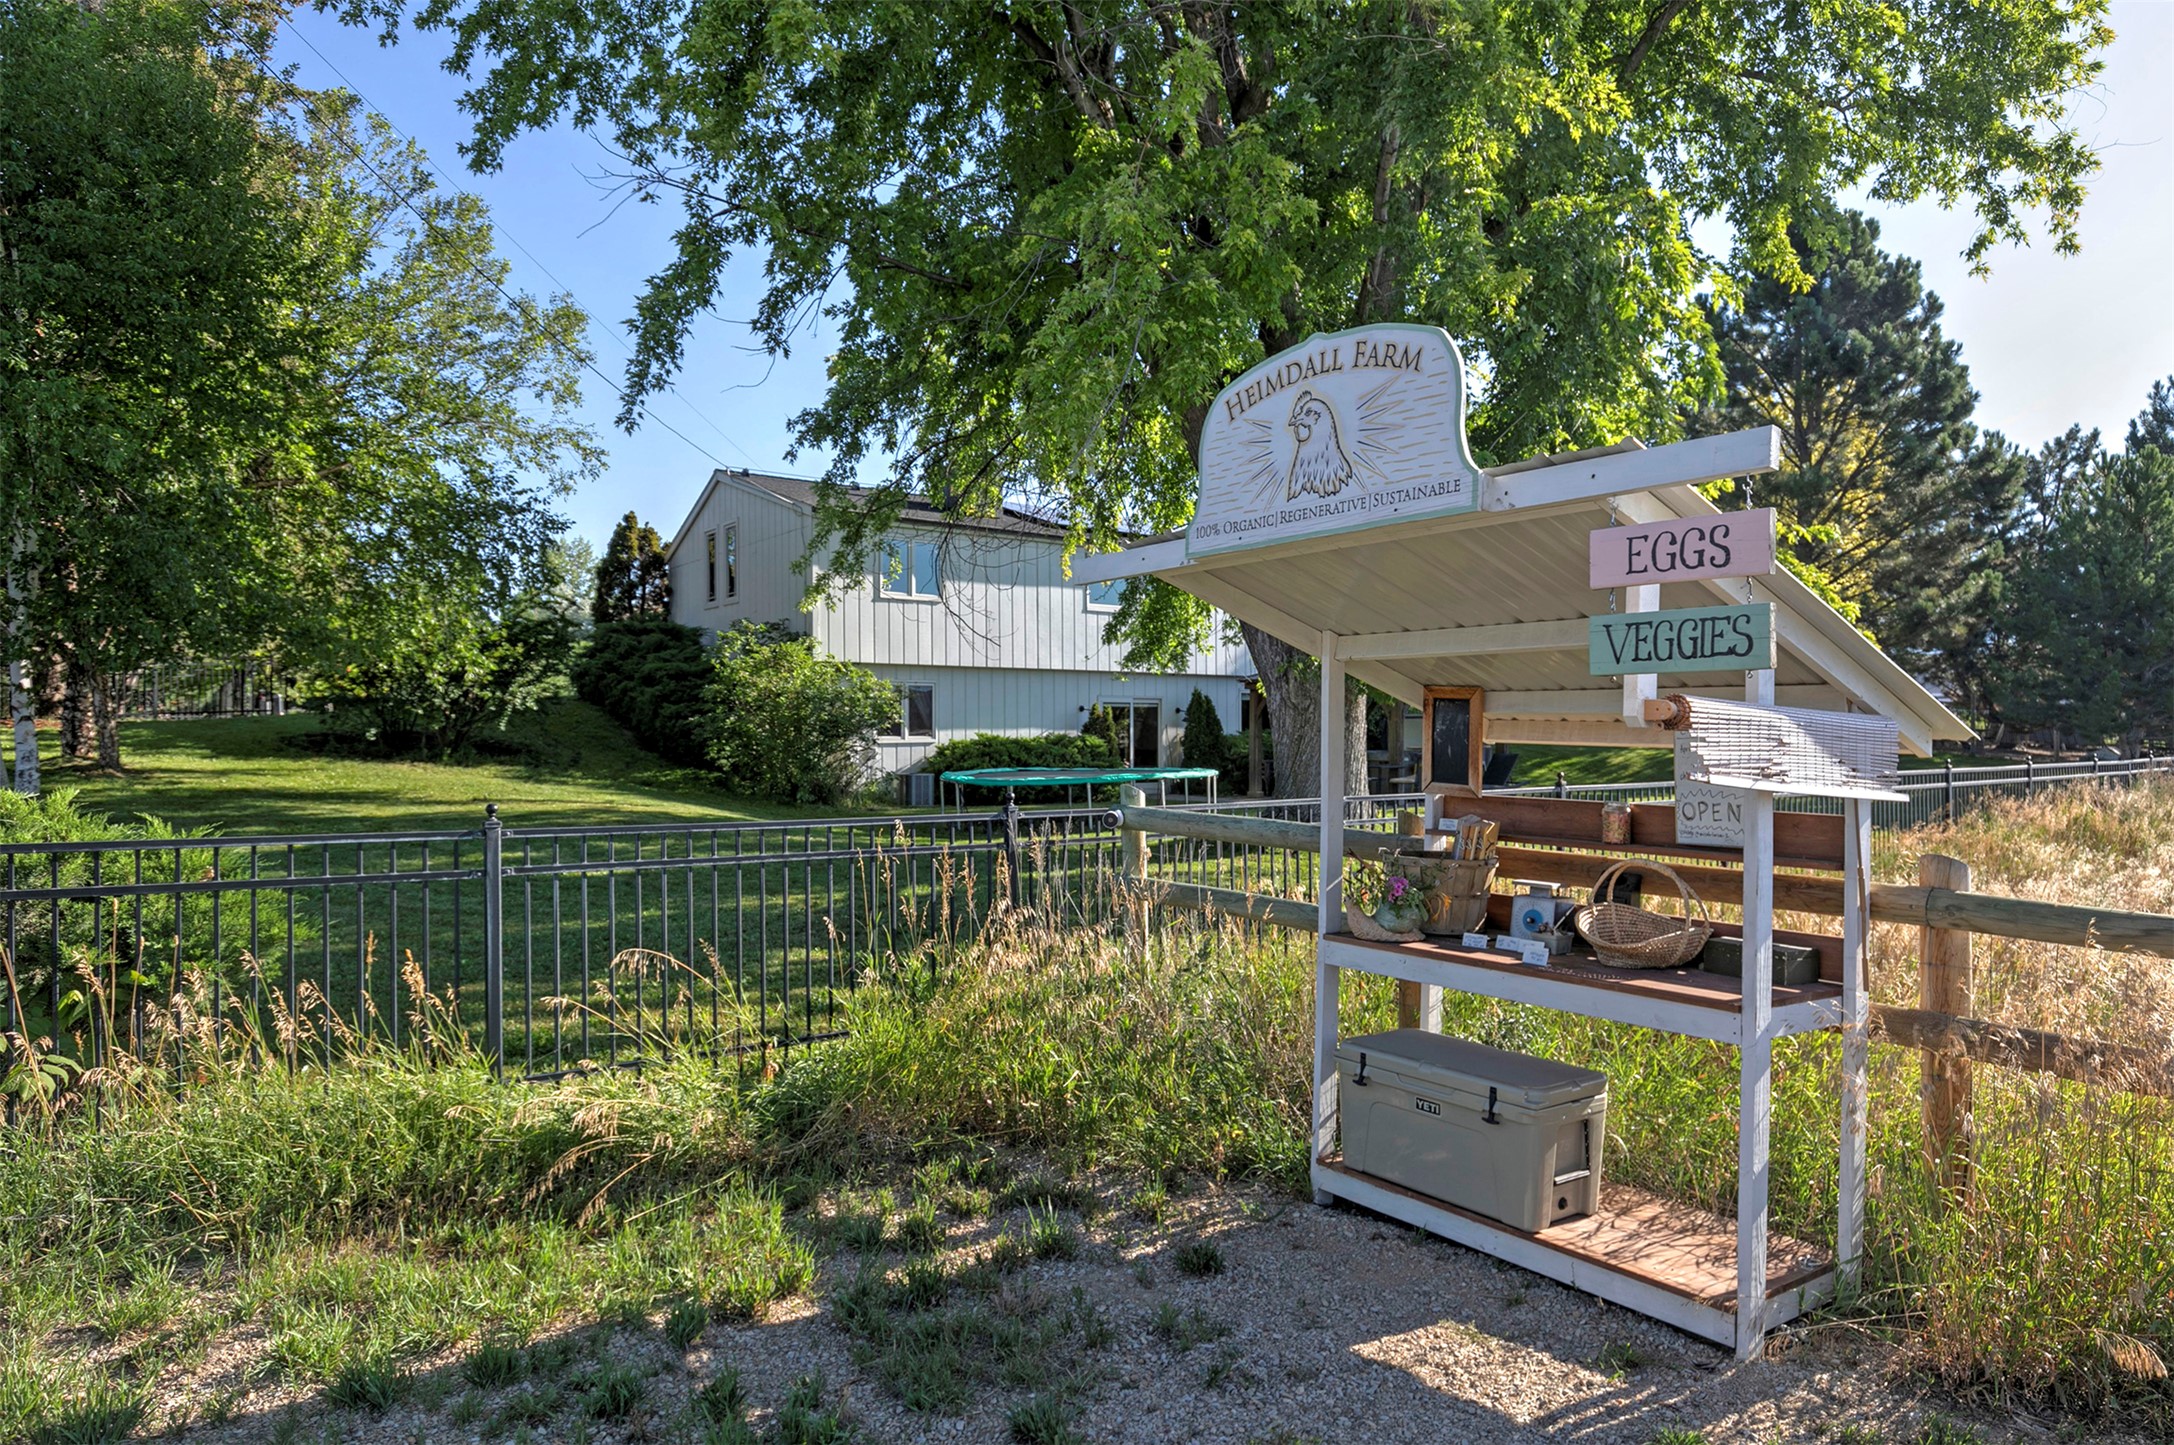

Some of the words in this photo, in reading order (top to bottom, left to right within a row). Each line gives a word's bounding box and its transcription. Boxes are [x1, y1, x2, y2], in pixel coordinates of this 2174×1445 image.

[1224, 348, 1344, 423] HEIMDALL
[1352, 340, 1424, 373] FARM
[1195, 522, 1221, 540] 100%
[1223, 513, 1275, 535] ORGANIC
[1280, 496, 1367, 525] REGENERATIVE
[1372, 478, 1462, 508] SUSTAINABLE
[1625, 524, 1731, 576] EGGS
[1602, 613, 1755, 666] VEGGIES
[1681, 801, 1743, 824] OPEN
[1416, 1098, 1440, 1115] YETI
